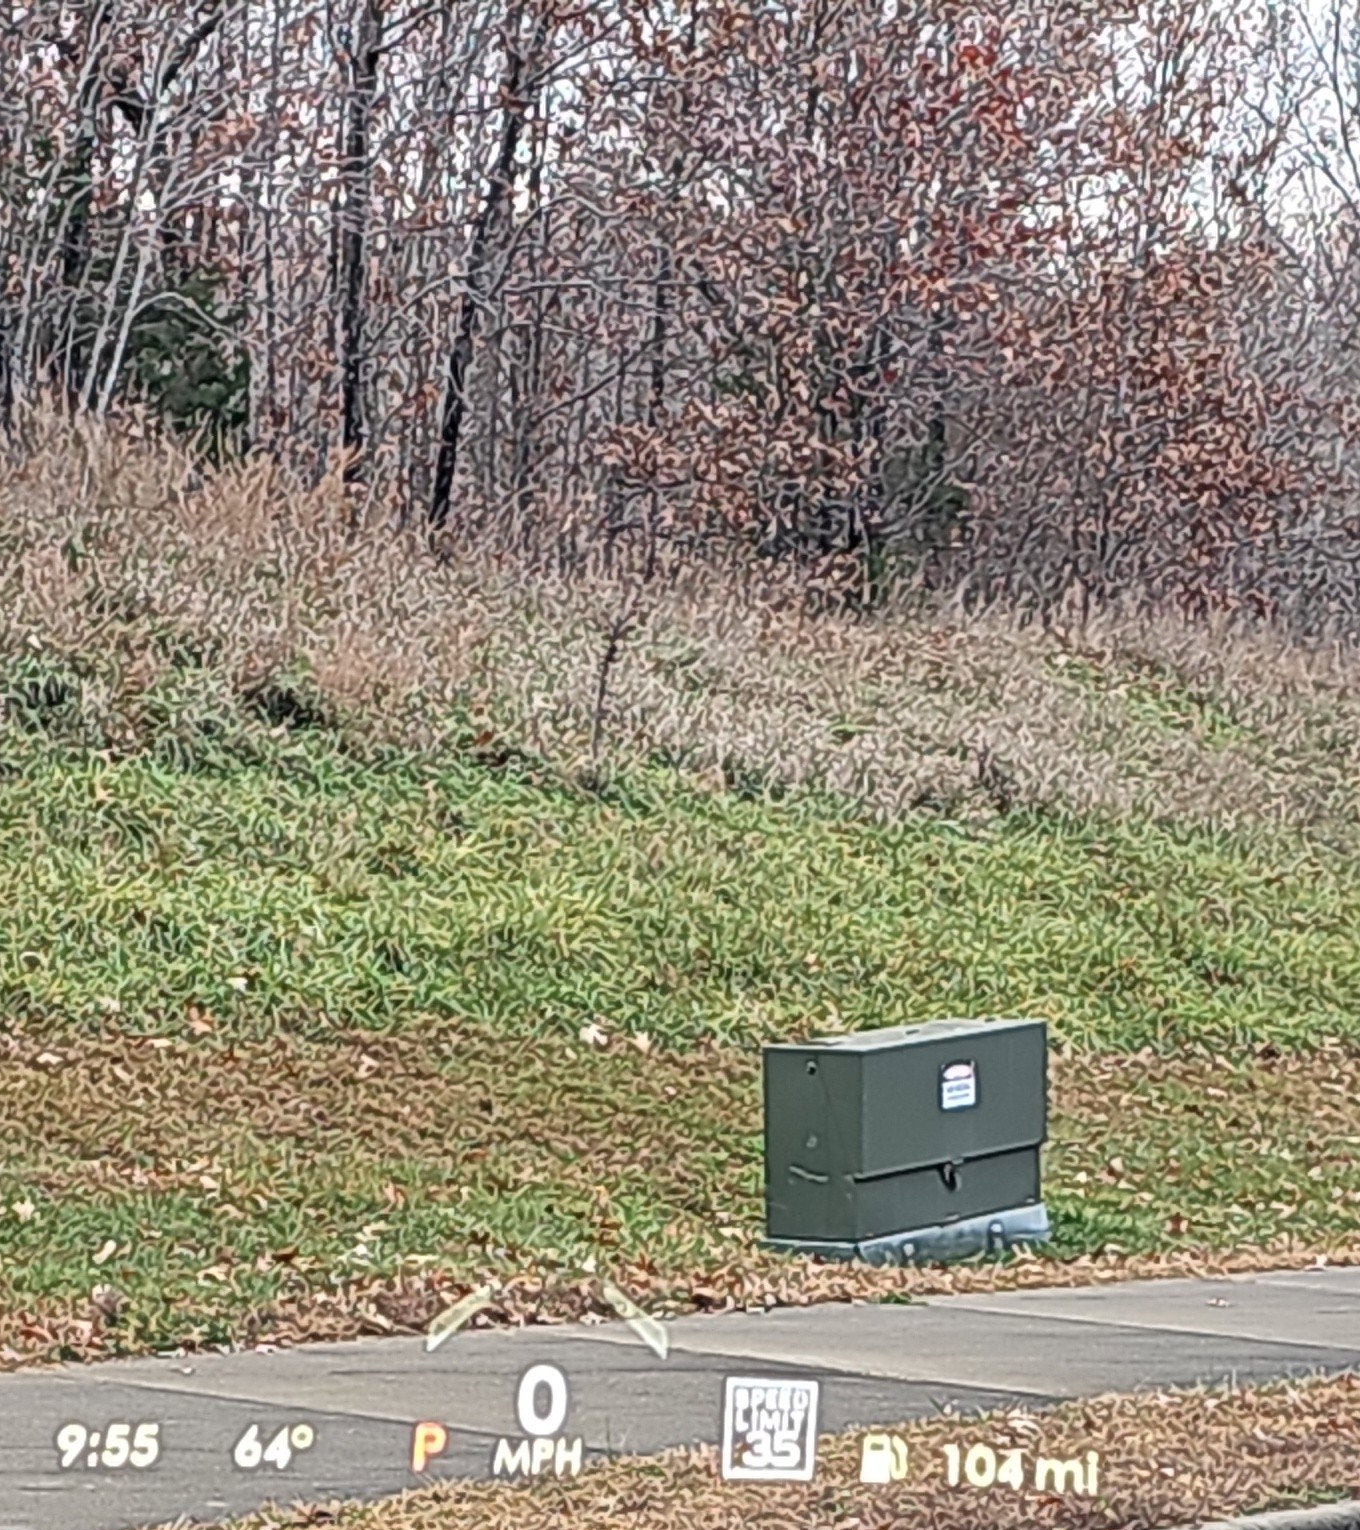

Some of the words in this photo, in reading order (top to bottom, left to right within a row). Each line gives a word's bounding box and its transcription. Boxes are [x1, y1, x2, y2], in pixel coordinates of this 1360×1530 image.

[517, 1364, 568, 1436] 0
[735, 1387, 809, 1410] SPEED
[735, 1409, 805, 1433] LIMIT
[56, 1423, 160, 1469] 9:55
[233, 1423, 315, 1470] 64°
[411, 1421, 449, 1474] P
[492, 1437, 583, 1477] MPH
[741, 1431, 801, 1467] 35
[943, 1443, 1024, 1491] 104
[1035, 1450, 1099, 1497] mi
